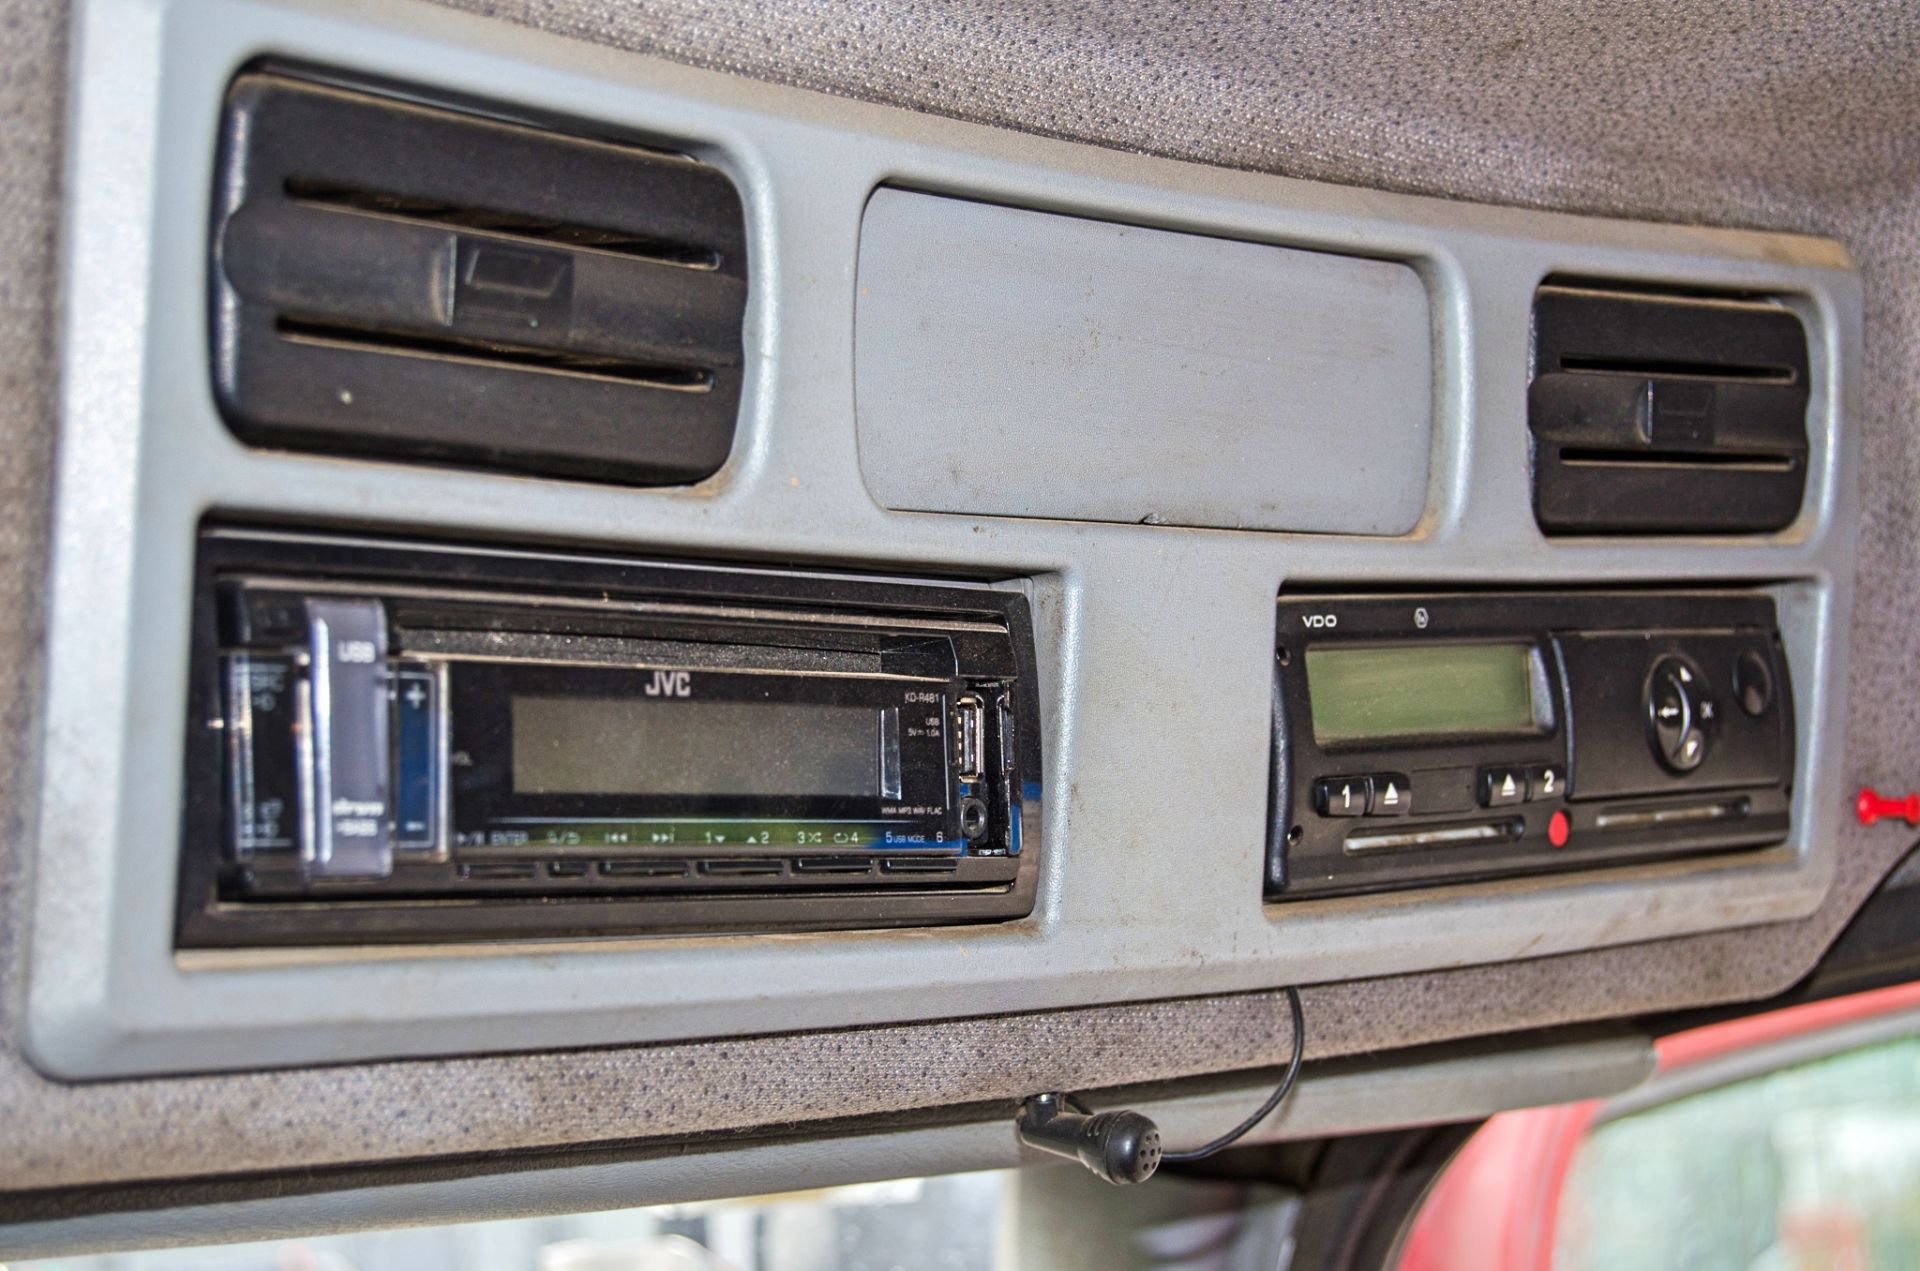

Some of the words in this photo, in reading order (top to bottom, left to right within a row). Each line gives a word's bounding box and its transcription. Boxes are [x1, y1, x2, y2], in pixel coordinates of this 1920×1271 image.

[1302, 615, 1337, 628] VDO
[337, 640, 376, 663] USB
[645, 671, 691, 697] JVC
[904, 692, 939, 703] KD-R481
[1543, 770, 1554, 793] 2
[1341, 784, 1350, 808] 1
[881, 806, 897, 815] WMA
[898, 806, 912, 815] MP3
[913, 806, 926, 815] WAV
[927, 806, 942, 815] FLAC
[705, 832, 711, 844] 1
[760, 831, 769, 844] 2
[797, 832, 805, 844] 3
[850, 832, 858, 844] 4
[885, 831, 893, 844] 5
[907, 835, 925, 844] MODE
[936, 831, 943, 844] 6
